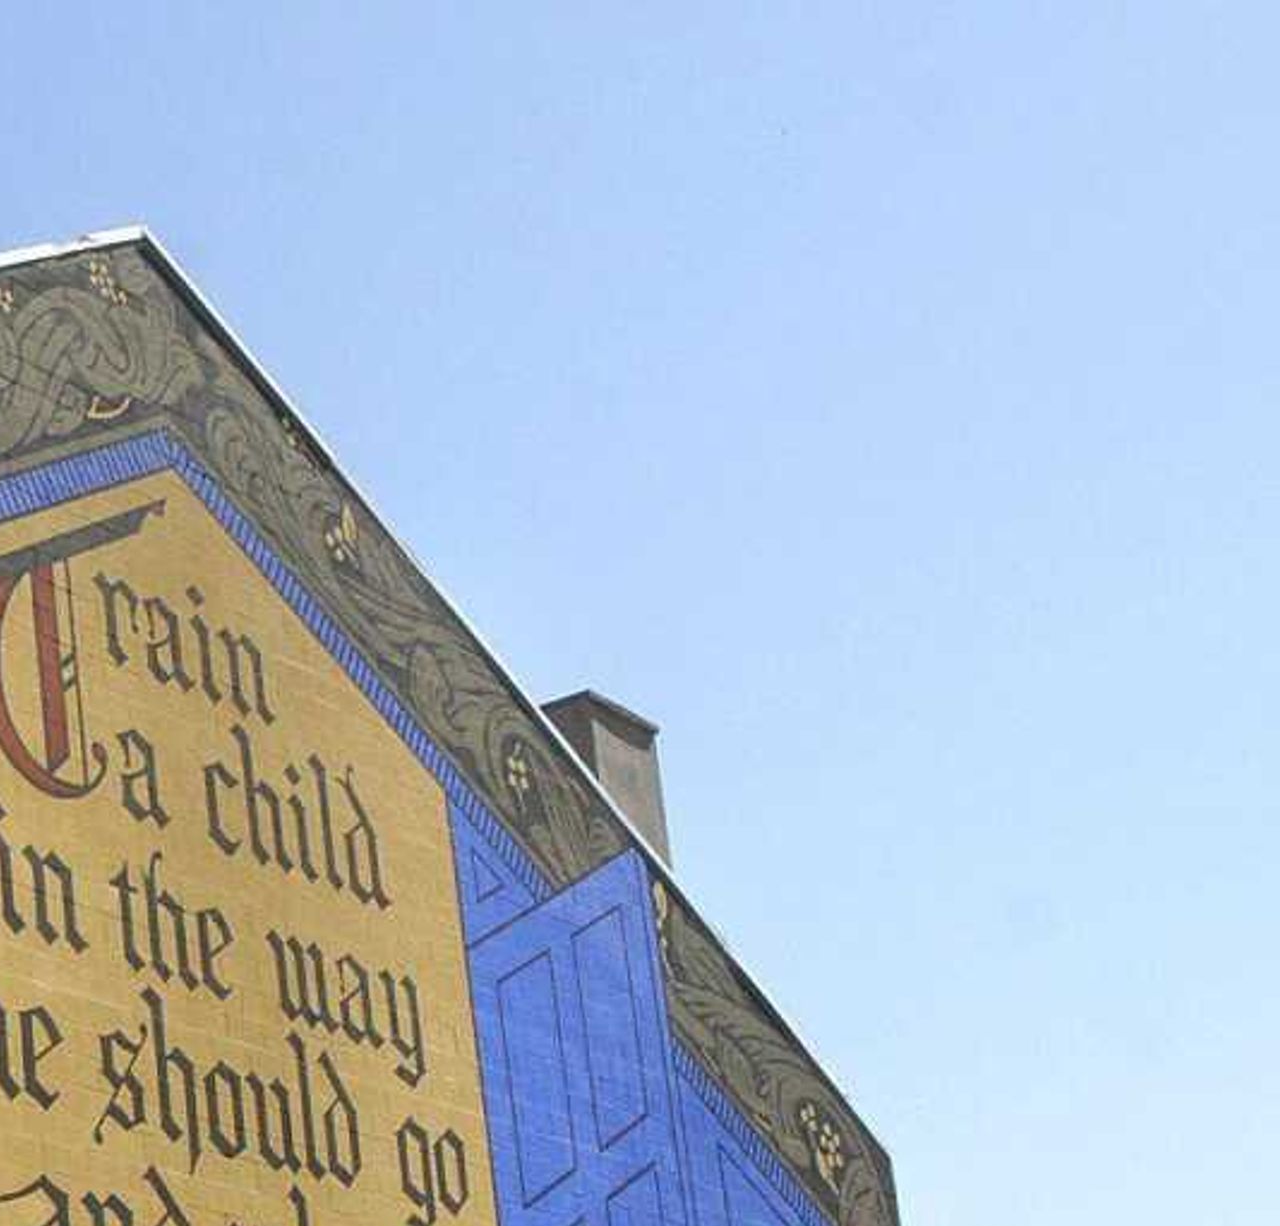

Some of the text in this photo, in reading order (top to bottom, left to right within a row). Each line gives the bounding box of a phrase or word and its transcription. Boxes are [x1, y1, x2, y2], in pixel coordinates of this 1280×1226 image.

[117, 724, 392, 909] a child
[109, 850, 234, 1000] the
[265, 928, 427, 1087] way
[93, 987, 363, 1188] should
